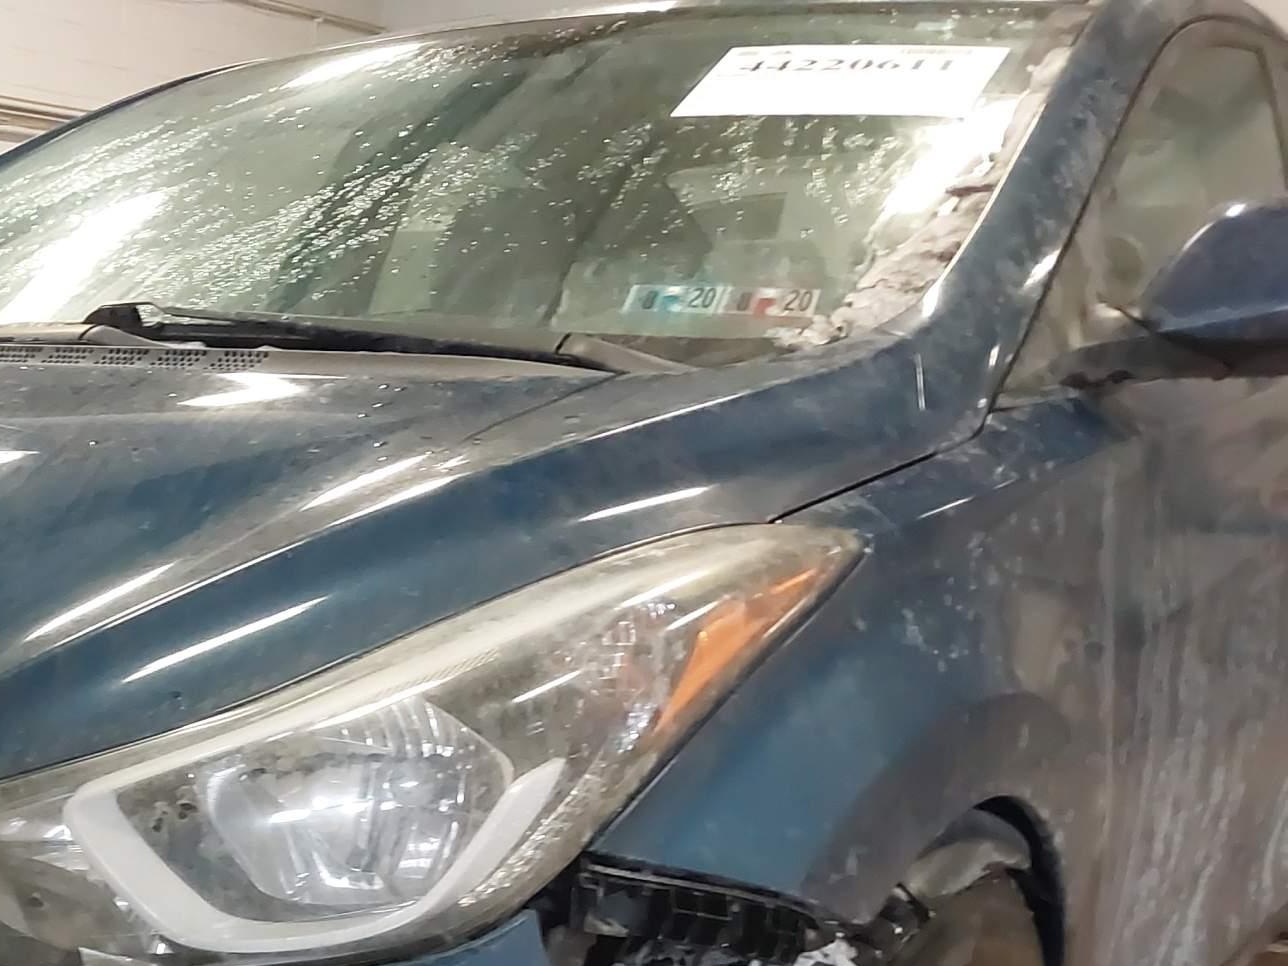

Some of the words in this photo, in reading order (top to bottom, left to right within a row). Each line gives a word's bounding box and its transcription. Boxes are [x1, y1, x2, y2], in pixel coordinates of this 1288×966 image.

[738, 58, 954, 73] 44220611
[687, 287, 717, 308] 20
[783, 289, 812, 312] 20
